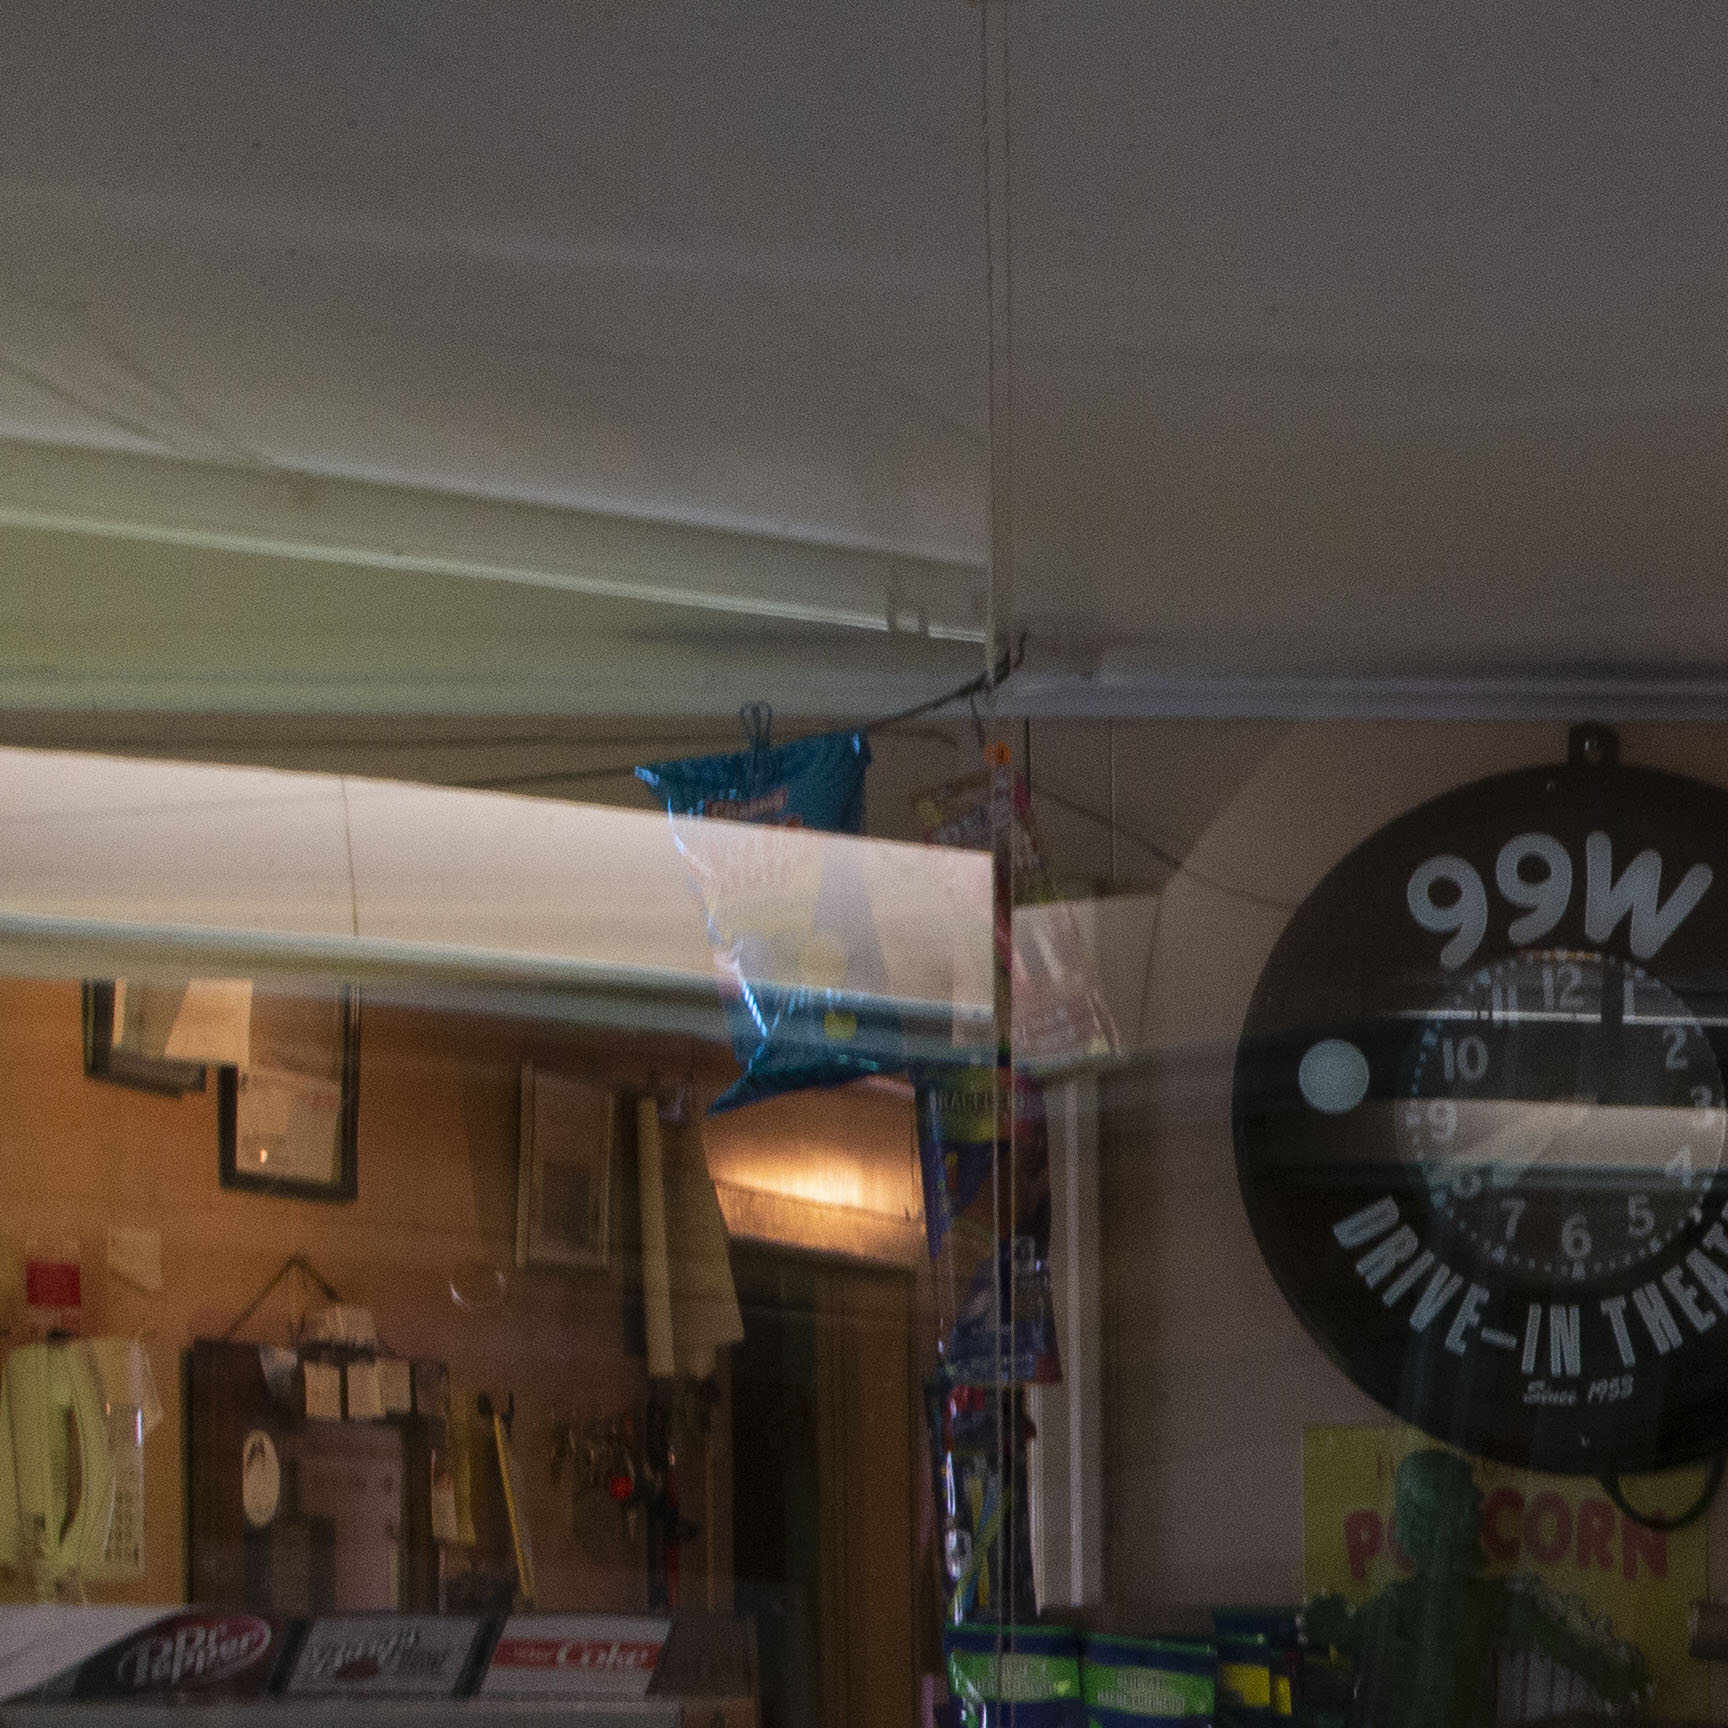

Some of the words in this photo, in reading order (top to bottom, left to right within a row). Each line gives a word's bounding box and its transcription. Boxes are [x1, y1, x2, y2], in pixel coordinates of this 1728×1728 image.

[1406, 830, 1714, 970] 99W
[1333, 1195, 1582, 1377] DRIVE-IN
[1345, 1487, 1669, 1582] PCORN
[557, 1640, 648, 1669] Coke
